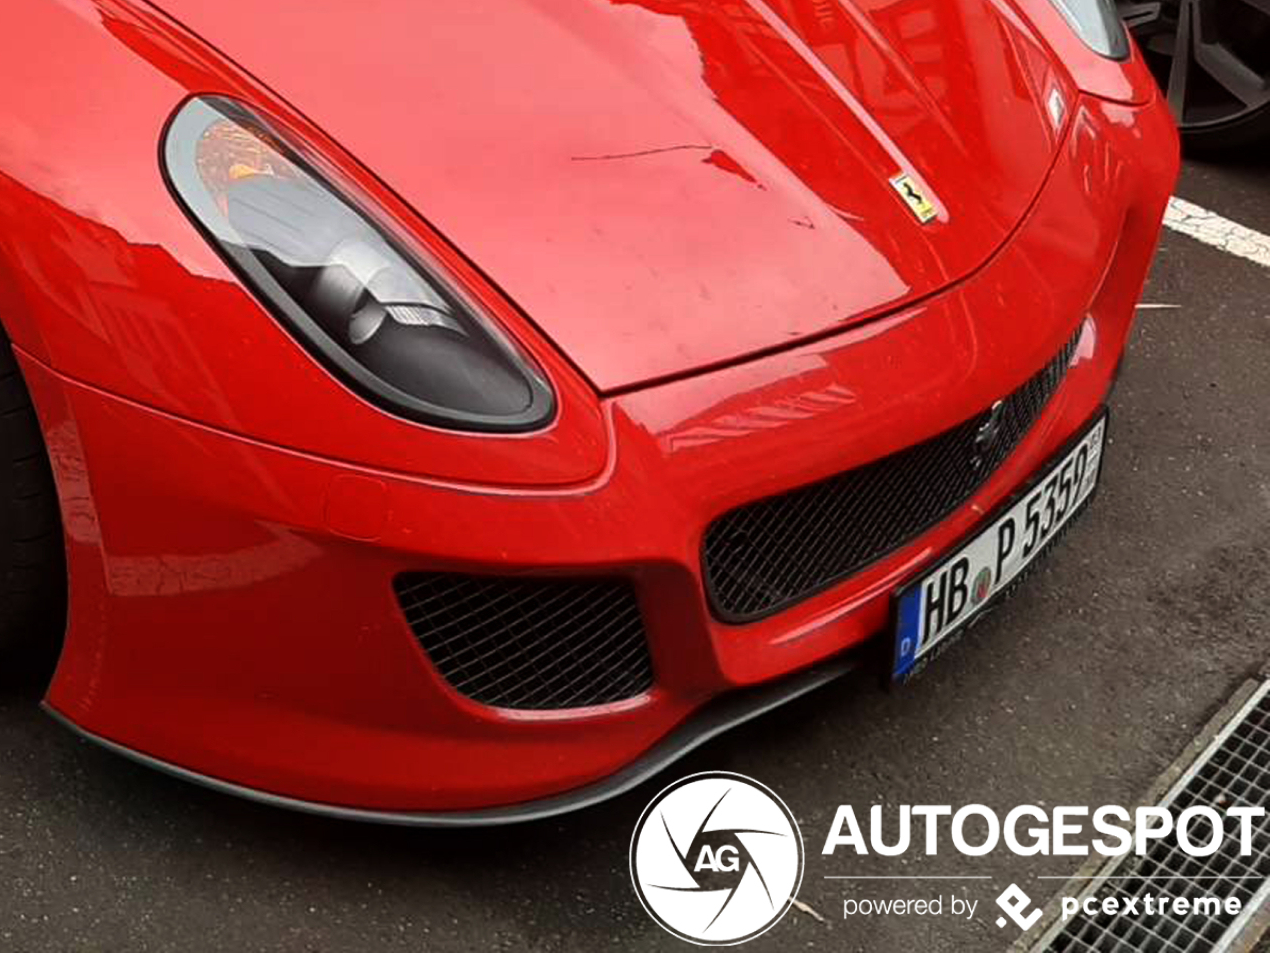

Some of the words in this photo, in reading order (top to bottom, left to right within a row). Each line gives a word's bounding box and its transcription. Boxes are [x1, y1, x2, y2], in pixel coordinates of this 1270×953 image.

[922, 556, 970, 646] HB
[994, 517, 1016, 586] P
[1022, 442, 1088, 559] 5359
